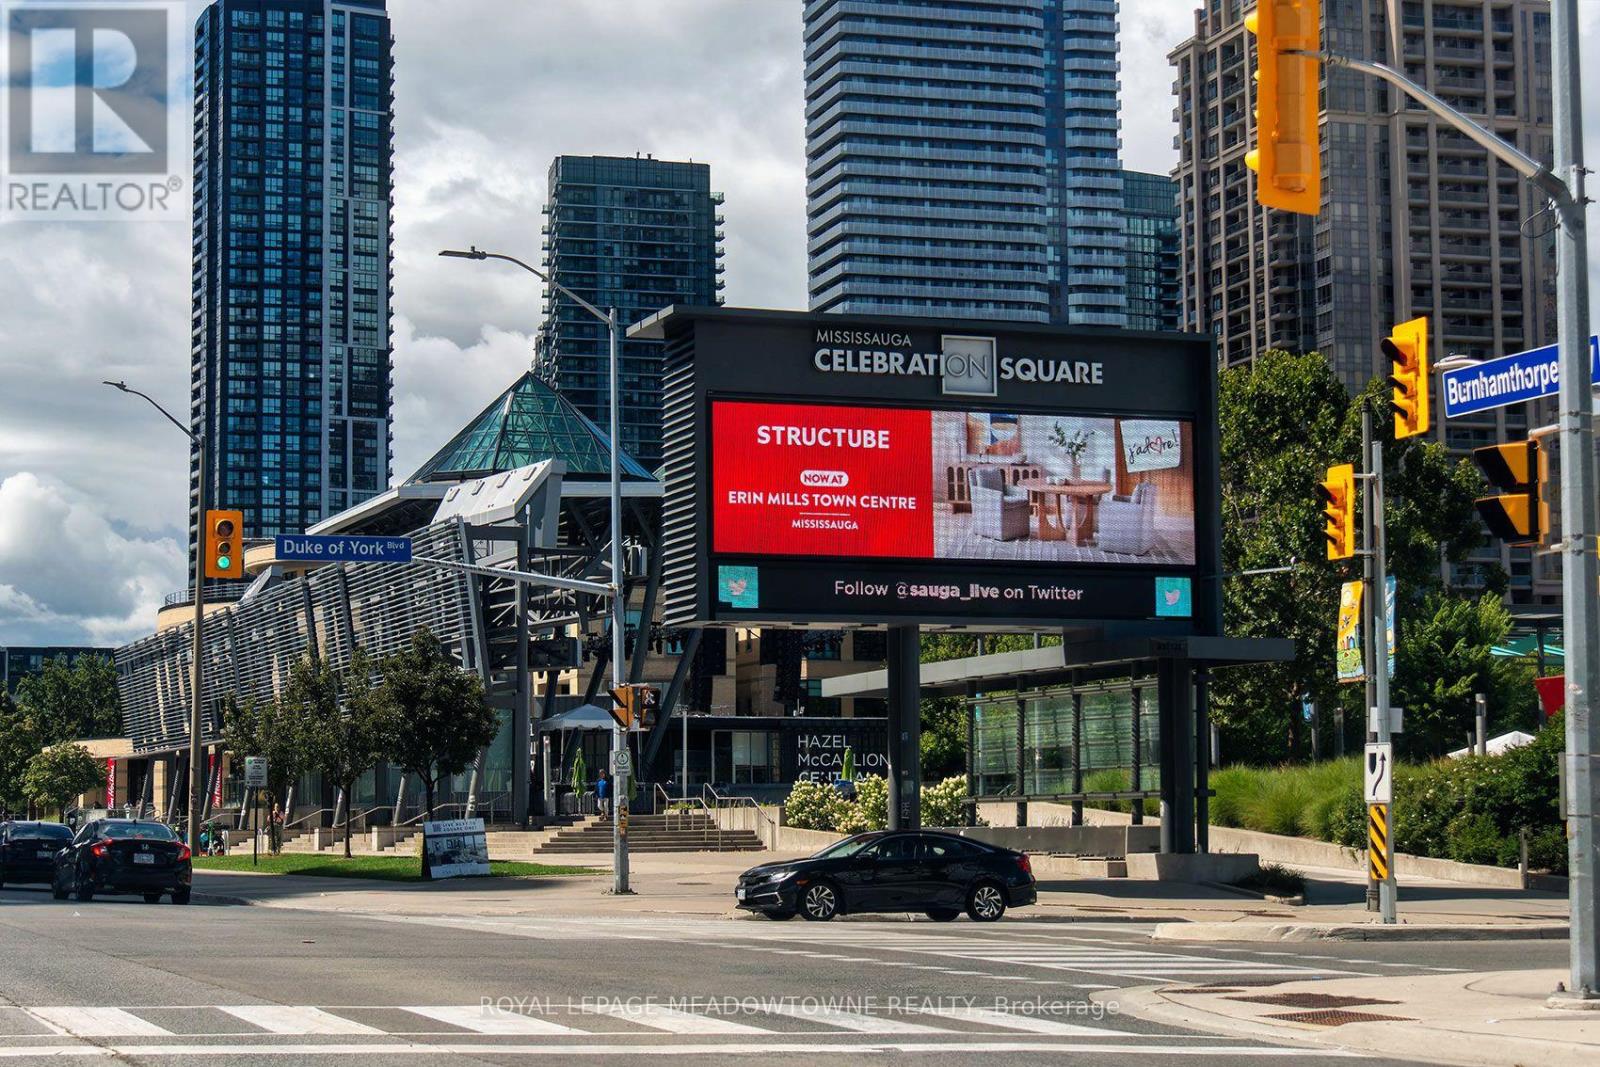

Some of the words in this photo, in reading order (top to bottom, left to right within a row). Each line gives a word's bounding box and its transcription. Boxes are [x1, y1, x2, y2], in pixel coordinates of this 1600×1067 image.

[816, 330, 912, 347] MISSISSAUGA
[814, 348, 989, 380] CELEBRATION
[1000, 357, 1103, 385] SQUARE
[1447, 360, 1560, 406] Burnhamthorpe
[757, 425, 890, 449] STRUCTUBE
[804, 473, 830, 483] NOW
[831, 474, 844, 484] AT
[728, 491, 764, 504] ERIN
[767, 492, 810, 506] MILLS
[812, 494, 857, 507] TOWN
[860, 495, 917, 509] CENTRE
[792, 519, 859, 530] MISSISSAUGA
[284, 540, 323, 554] Duke
[328, 541, 345, 554] of
[350, 541, 384, 556] York
[387, 541, 405, 549] Blvd
[834, 580, 889, 596] Follow
[1003, 586, 1024, 599] on
[1027, 585, 1084, 600] Twitter
[797, 735, 852, 748] HAZEL
[798, 753, 890, 767] McCALION
